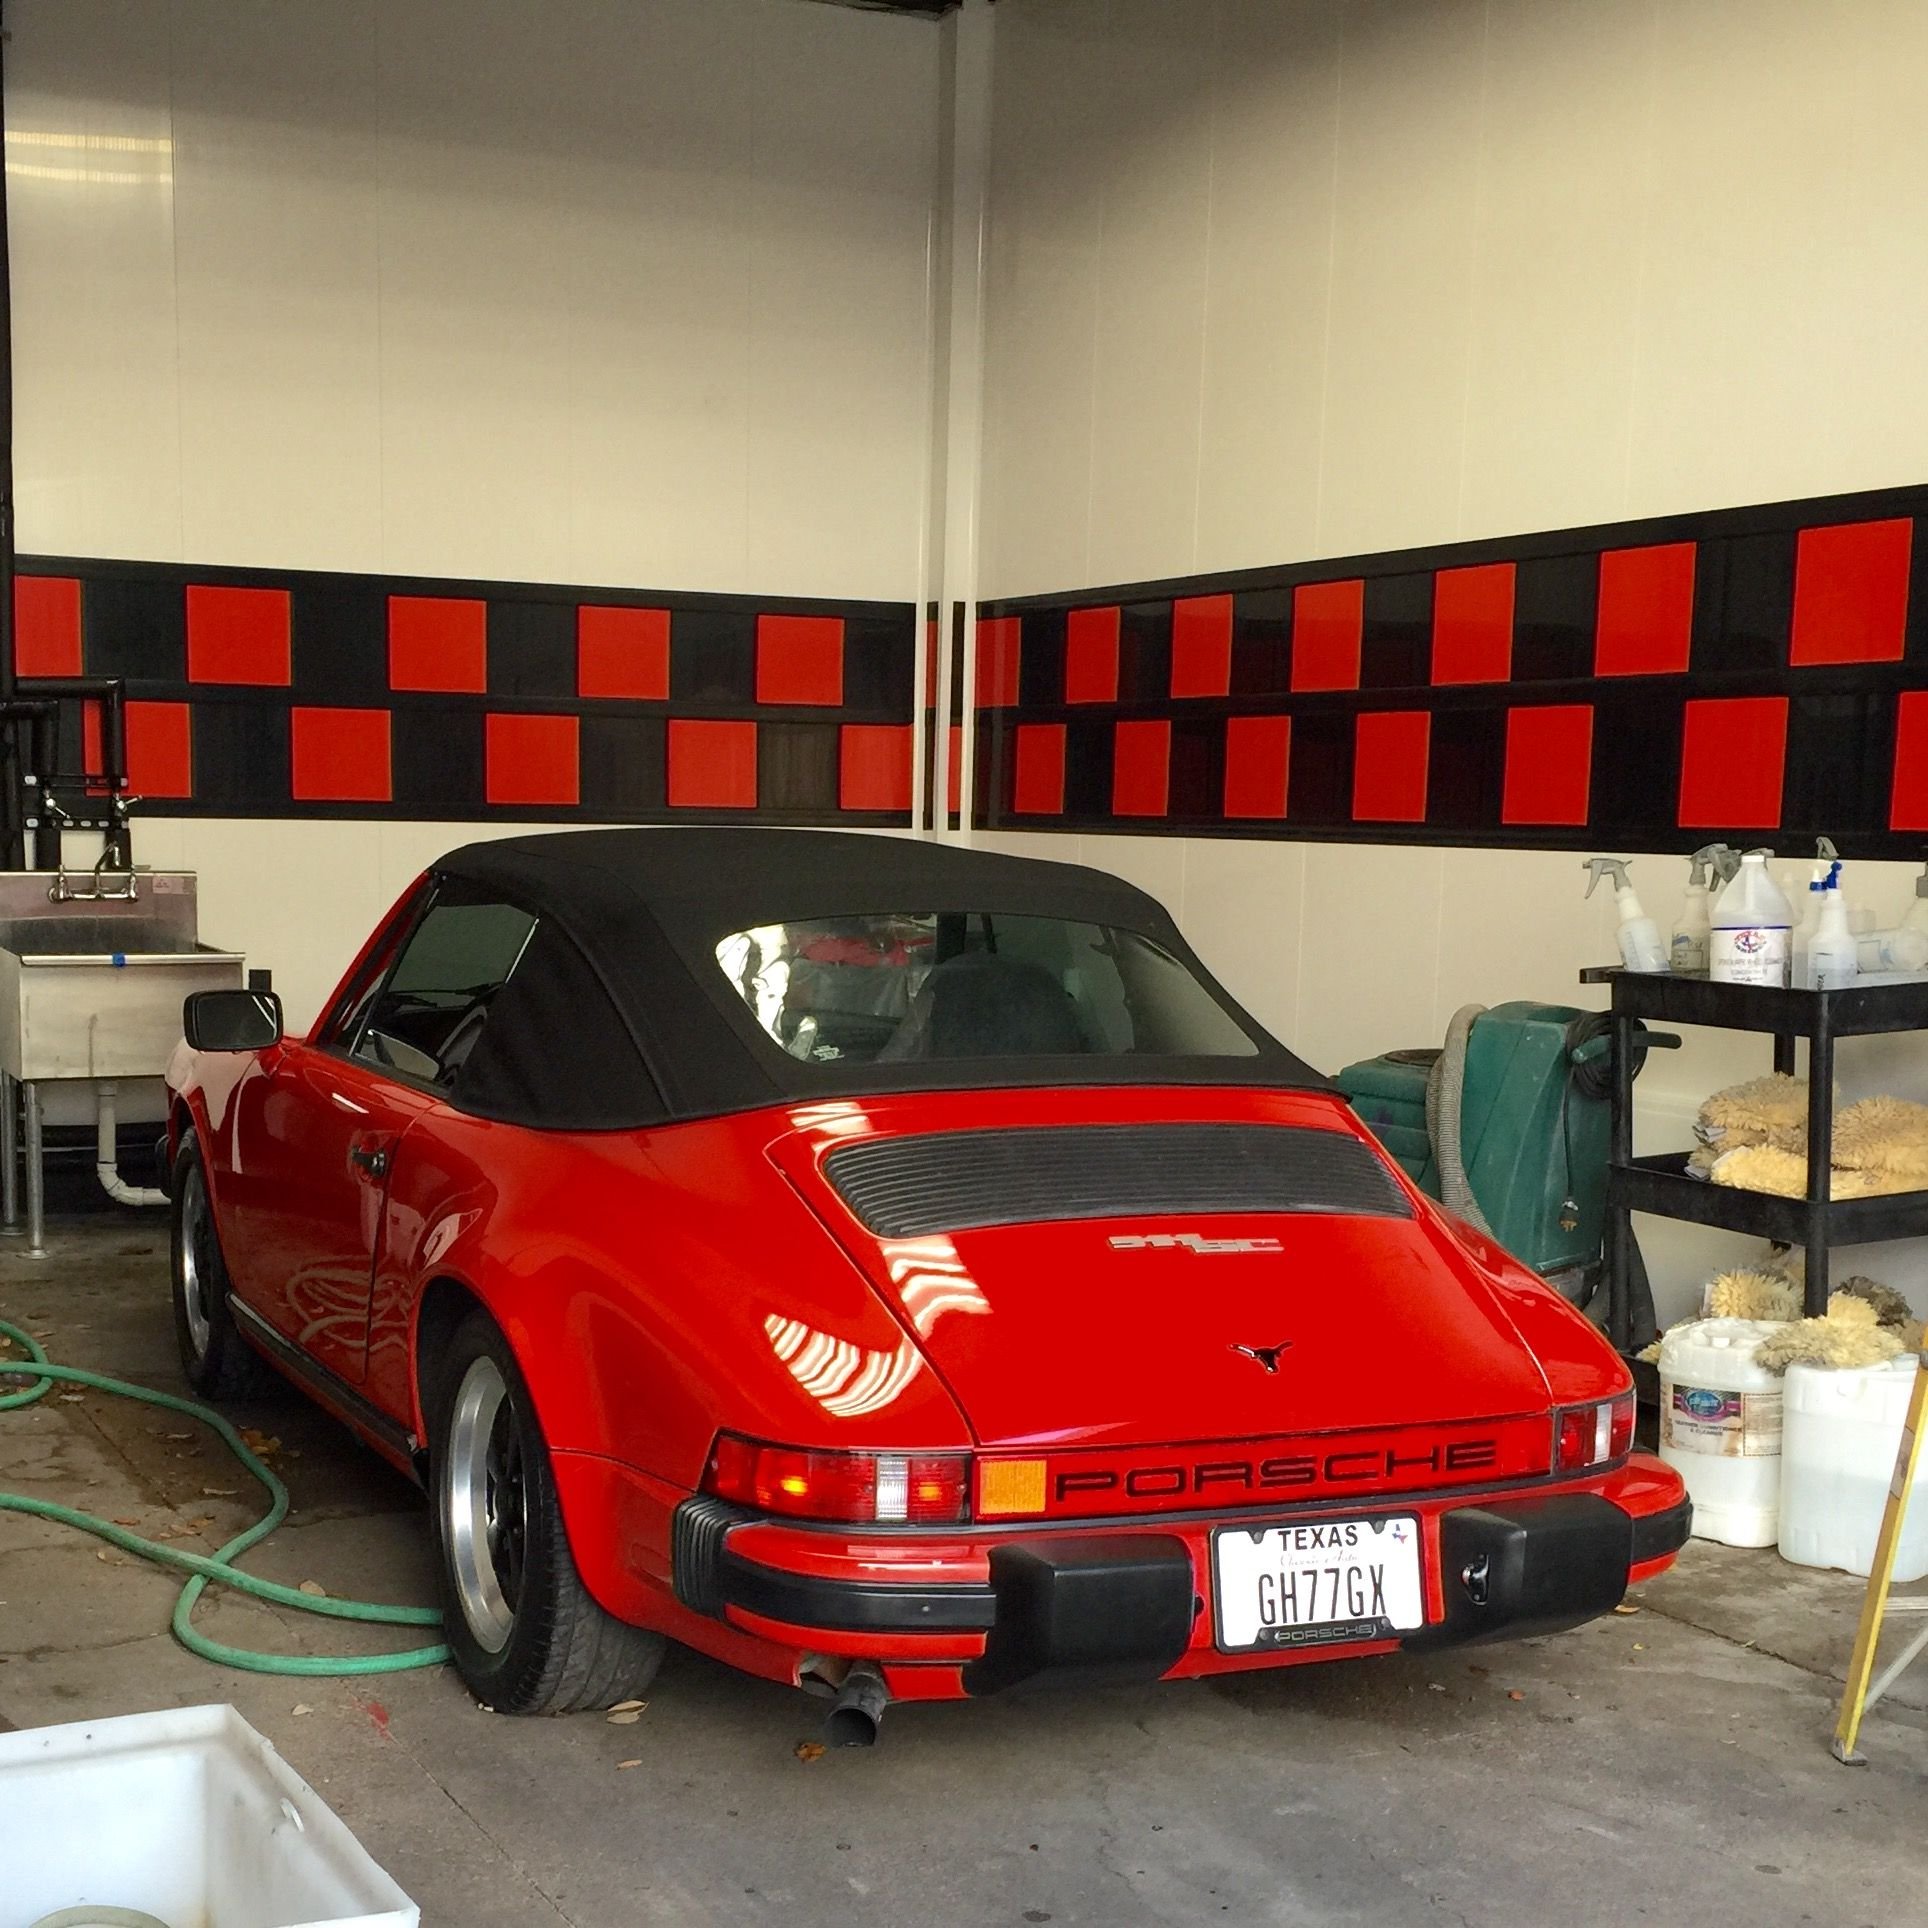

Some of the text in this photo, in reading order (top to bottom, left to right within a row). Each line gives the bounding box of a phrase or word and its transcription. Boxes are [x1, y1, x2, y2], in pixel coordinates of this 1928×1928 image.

[1055, 1440, 1497, 1502] PORSCHE
[1278, 1525, 1359, 1552] TEXAS
[1258, 1564, 1387, 1626] GH77GX
[1276, 1624, 1375, 1643] PORSCHE
